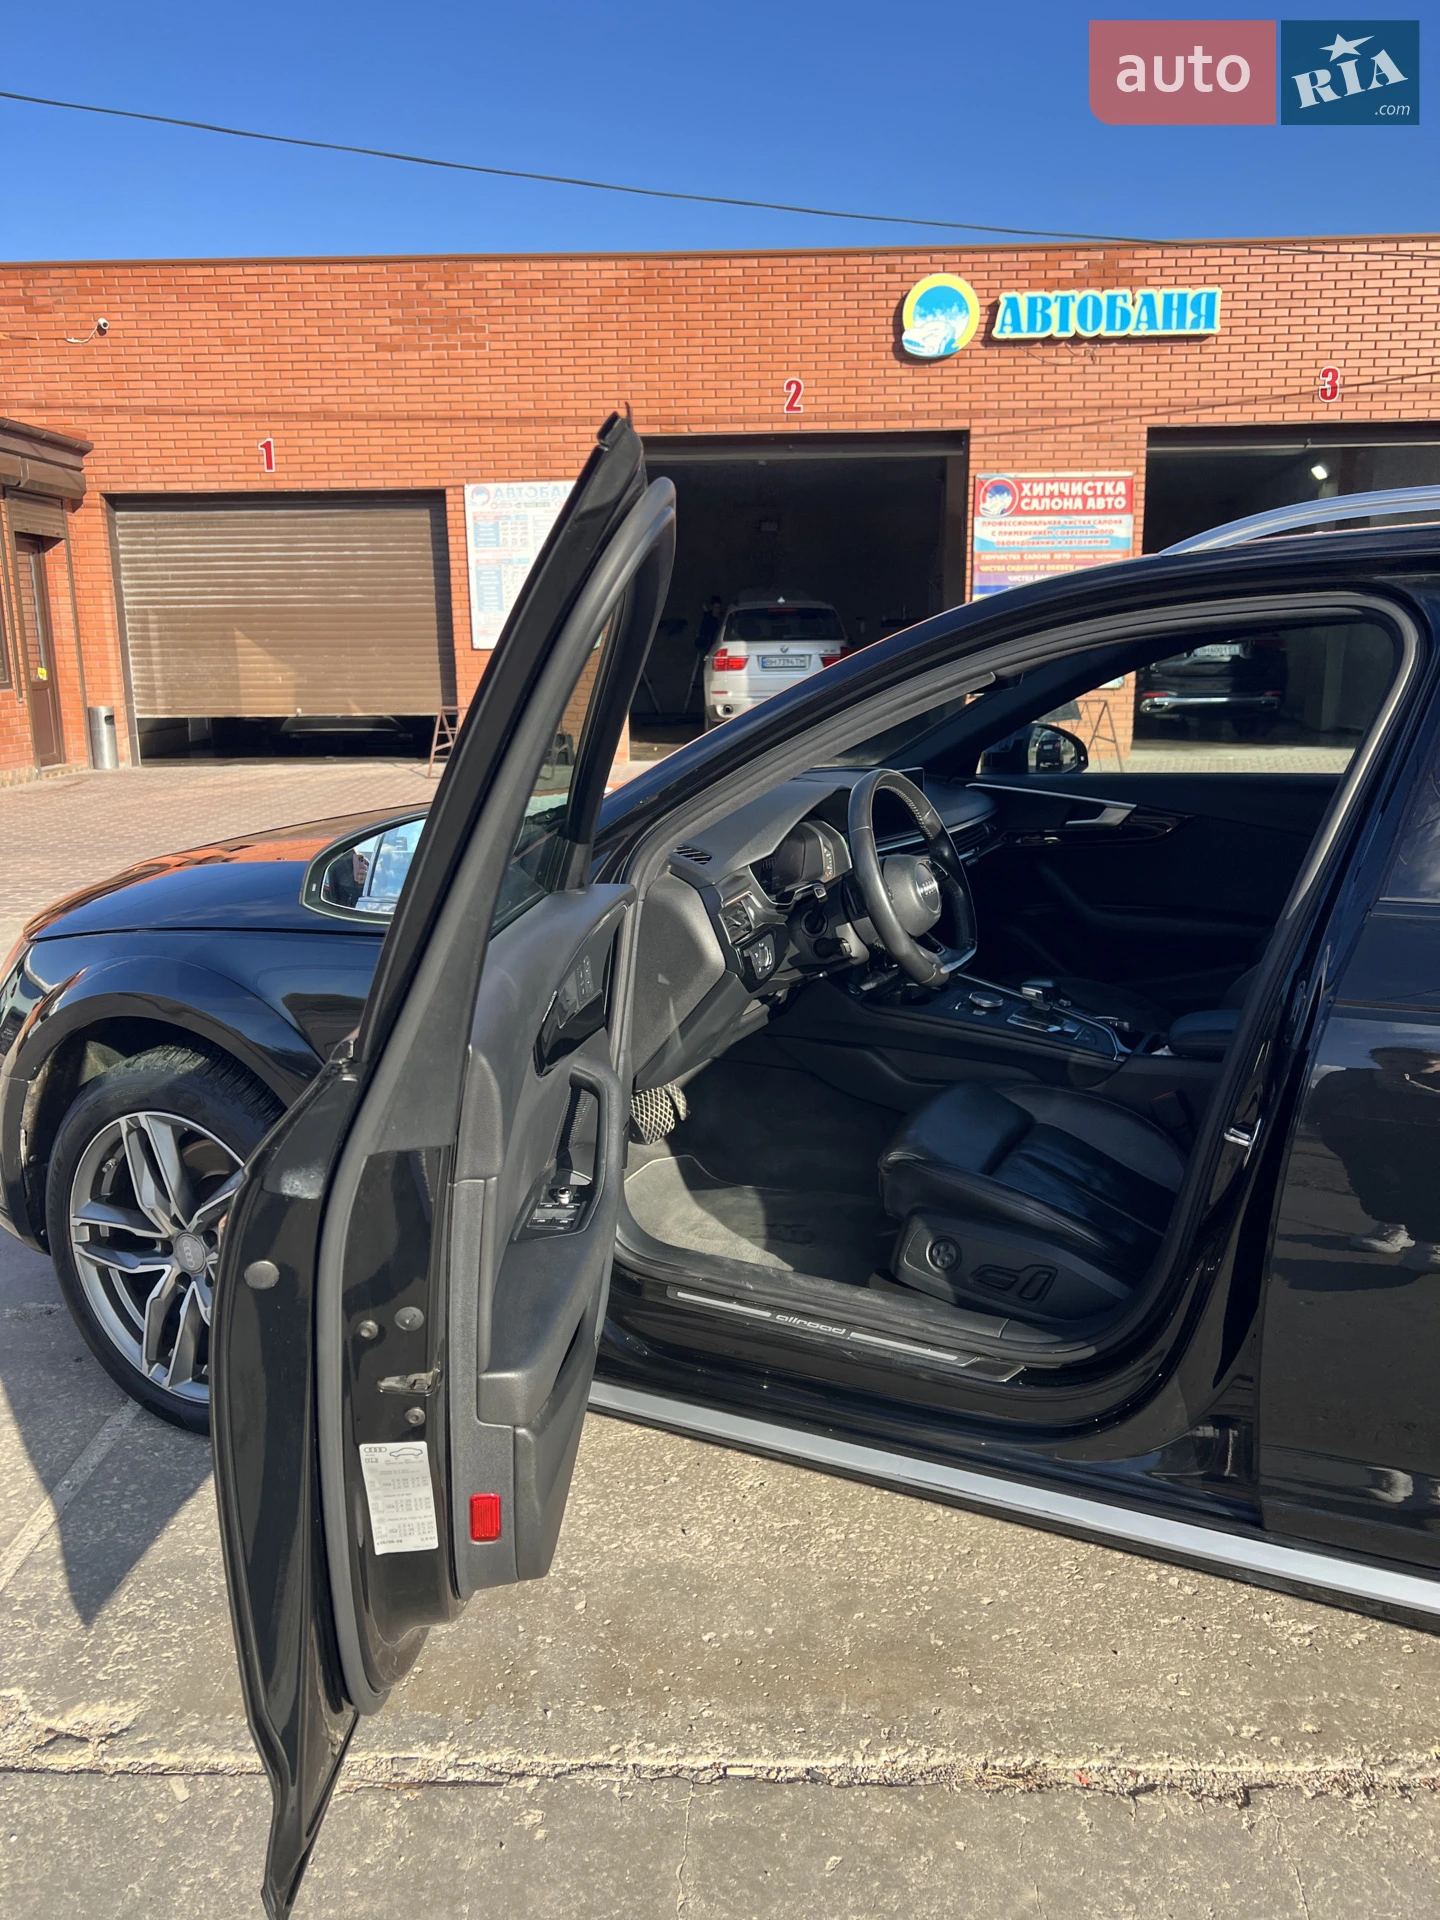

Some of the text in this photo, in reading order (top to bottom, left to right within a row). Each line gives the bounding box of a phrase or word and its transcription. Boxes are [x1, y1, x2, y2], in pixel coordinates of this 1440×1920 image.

[995, 289, 1221, 336] АВТОБАНЯ
[784, 378, 804, 414] 2
[1319, 366, 1340, 402] 3
[258, 438, 275, 473] 1
[1020, 481, 1126, 497] ХИМЧИСТКА
[1020, 496, 1126, 511] САЛОНА АВТО
[982, 519, 1061, 527] ПРОФЕССИОНАЛЬНАЯ
[1093, 518, 1123, 526] САЛОНА
[775, 1314, 847, 1335] allroad
